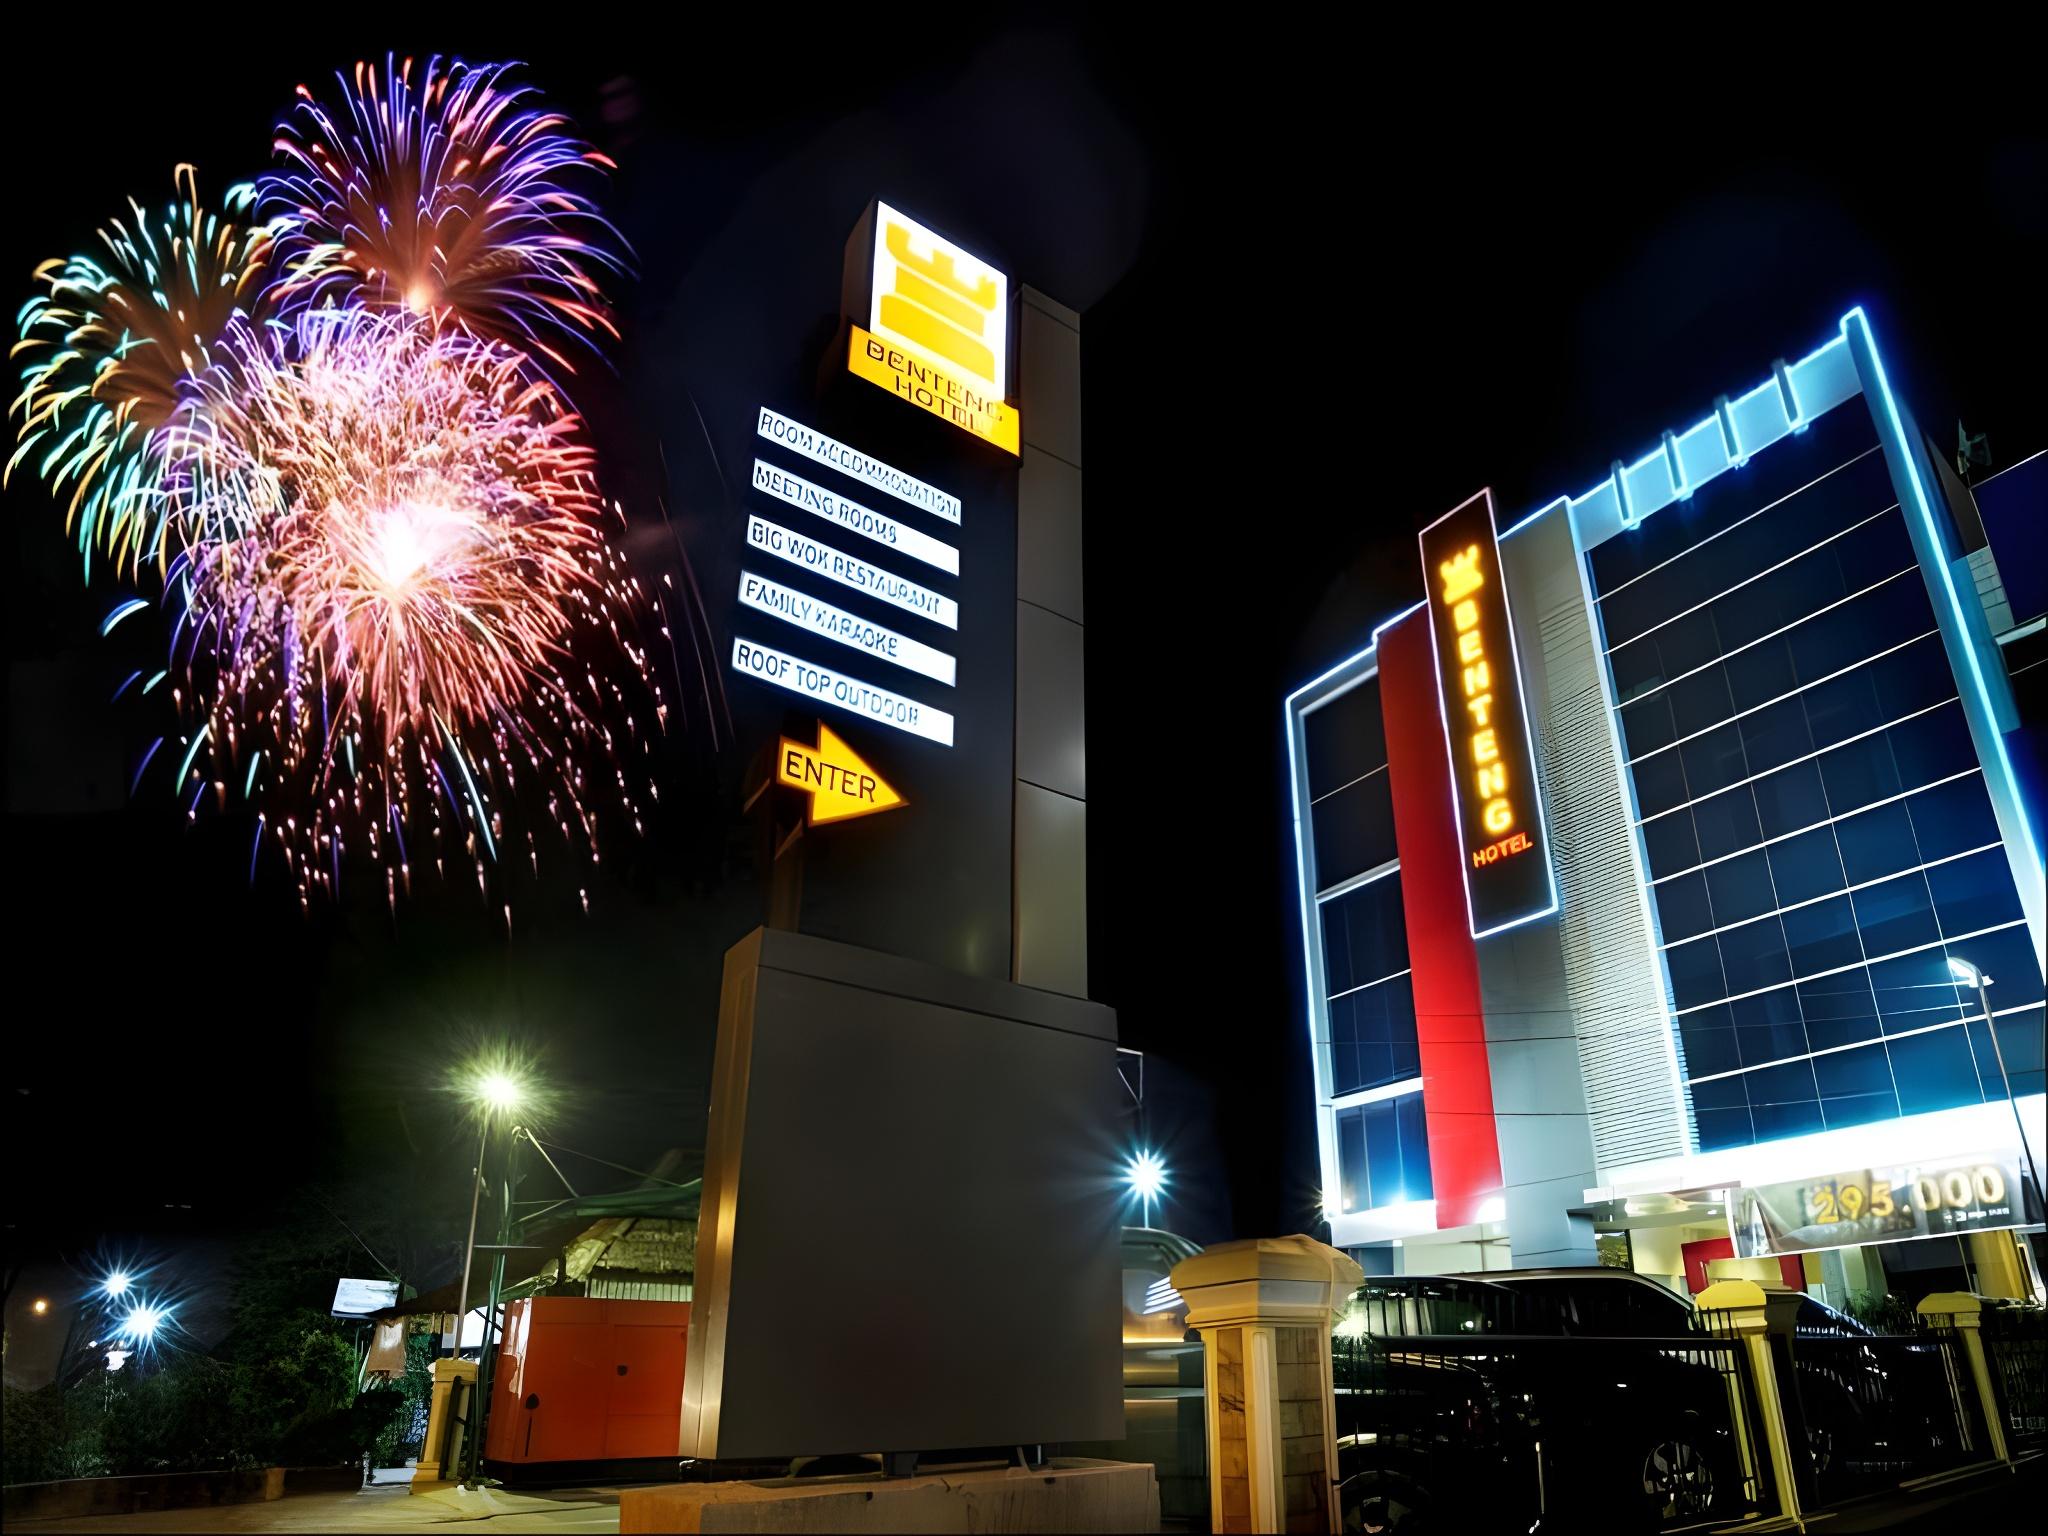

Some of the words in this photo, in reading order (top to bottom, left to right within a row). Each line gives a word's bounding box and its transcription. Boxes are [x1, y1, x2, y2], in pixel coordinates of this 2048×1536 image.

[760, 412, 812, 451] ROOM
[755, 465, 834, 515] MEETING
[839, 503, 897, 544] ROOMS
[752, 521, 782, 551] BIG
[787, 536, 829, 570] WOK
[745, 579, 812, 621] FAMILY
[815, 608, 898, 658] KARAOKE
[737, 643, 791, 679] ROOF
[796, 664, 831, 694] TOP
[834, 681, 919, 726] OUTDOOR
[1453, 597, 1513, 834] BENTENG
[785, 749, 877, 803] ENTER
[1472, 832, 1533, 868] HOTEL
[1811, 1165, 2005, 1225] 295.000
